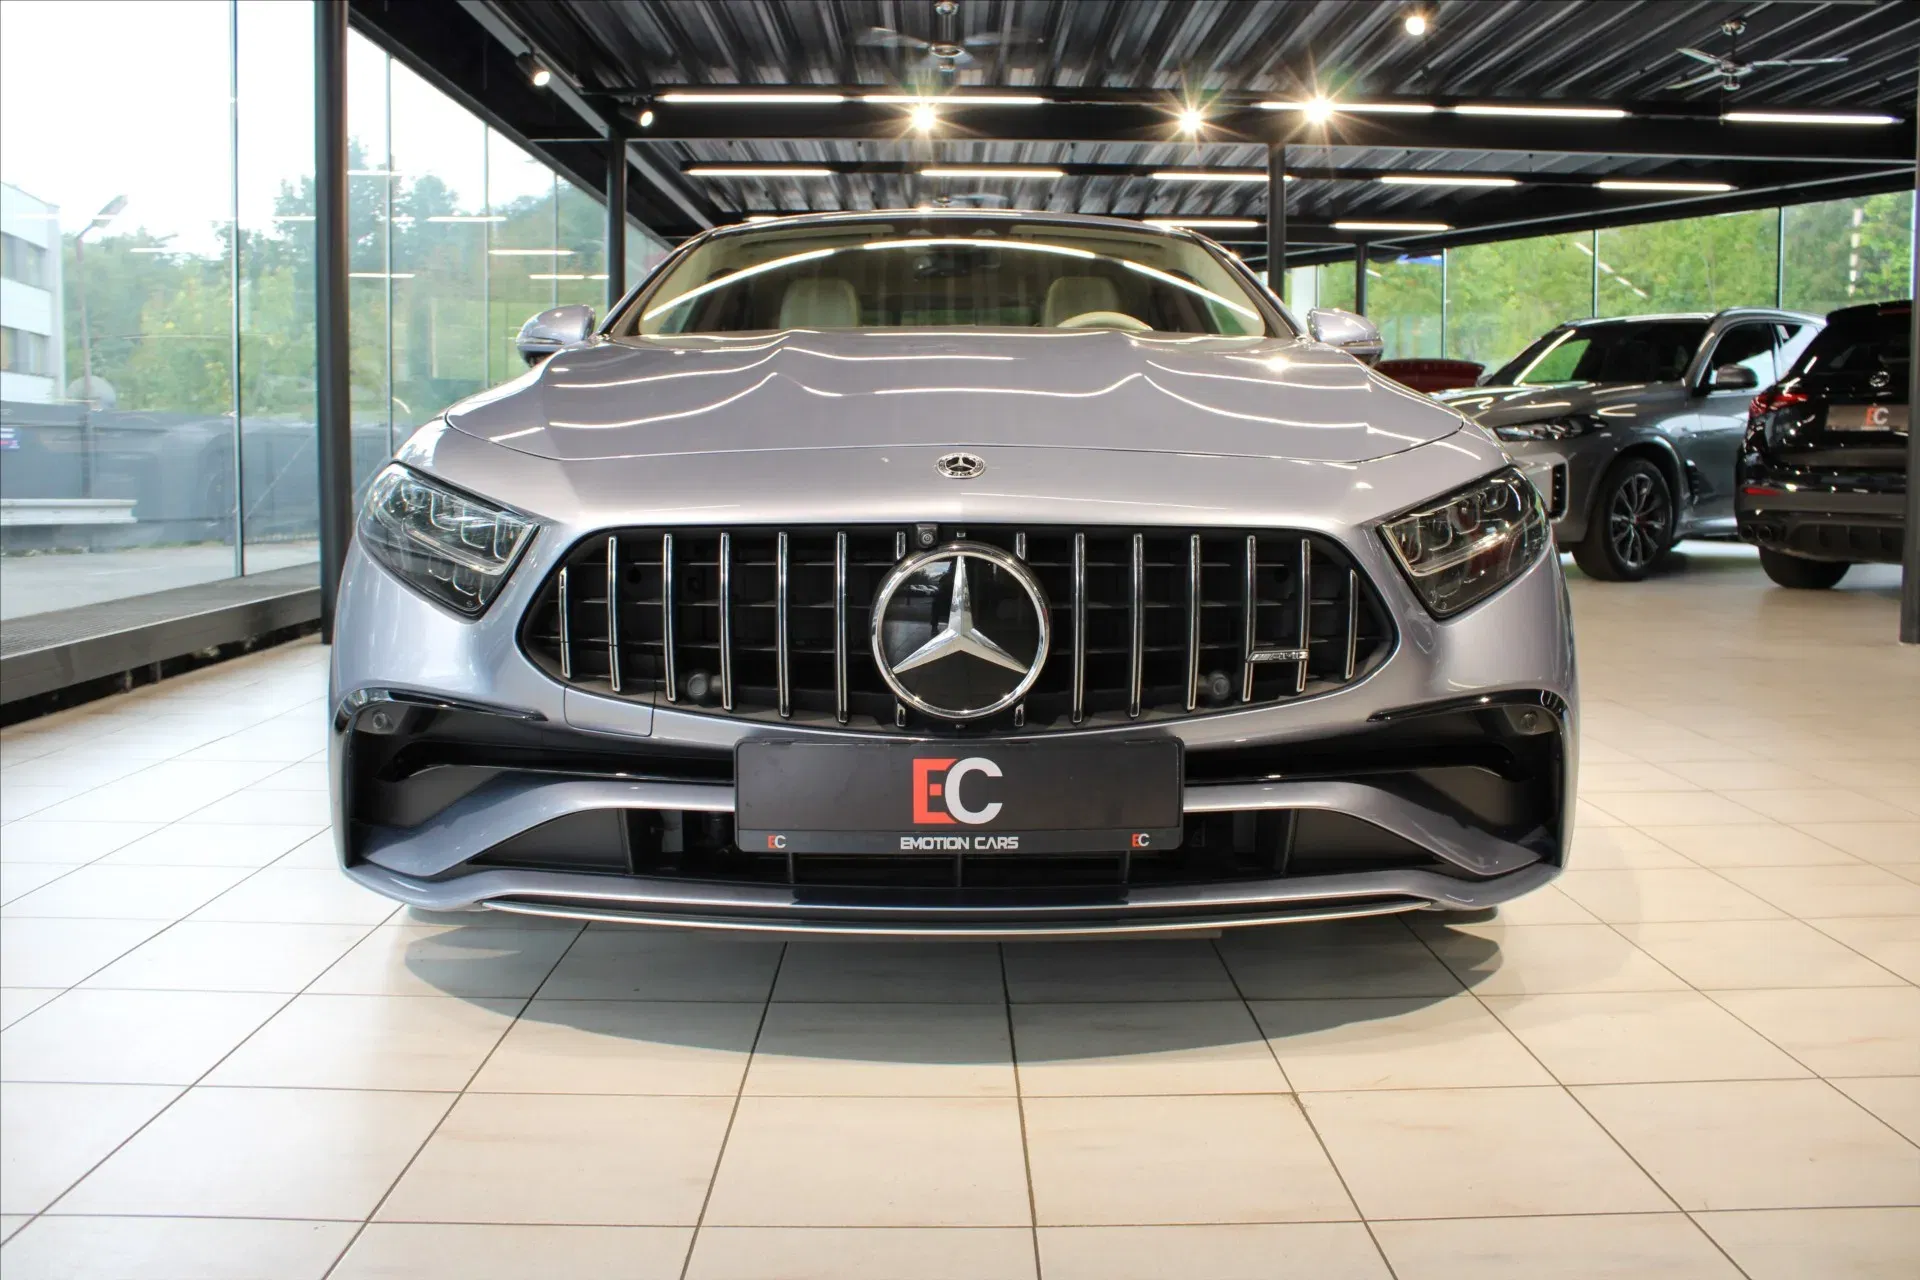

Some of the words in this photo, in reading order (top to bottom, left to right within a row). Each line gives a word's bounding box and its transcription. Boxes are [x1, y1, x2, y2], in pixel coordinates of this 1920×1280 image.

[1866, 406, 1889, 425] EC
[913, 757, 1003, 825] EC
[768, 835, 786, 848] EC
[900, 836, 970, 850] EMOTION
[974, 836, 1019, 850] CARS
[1132, 833, 1150, 847] EC
